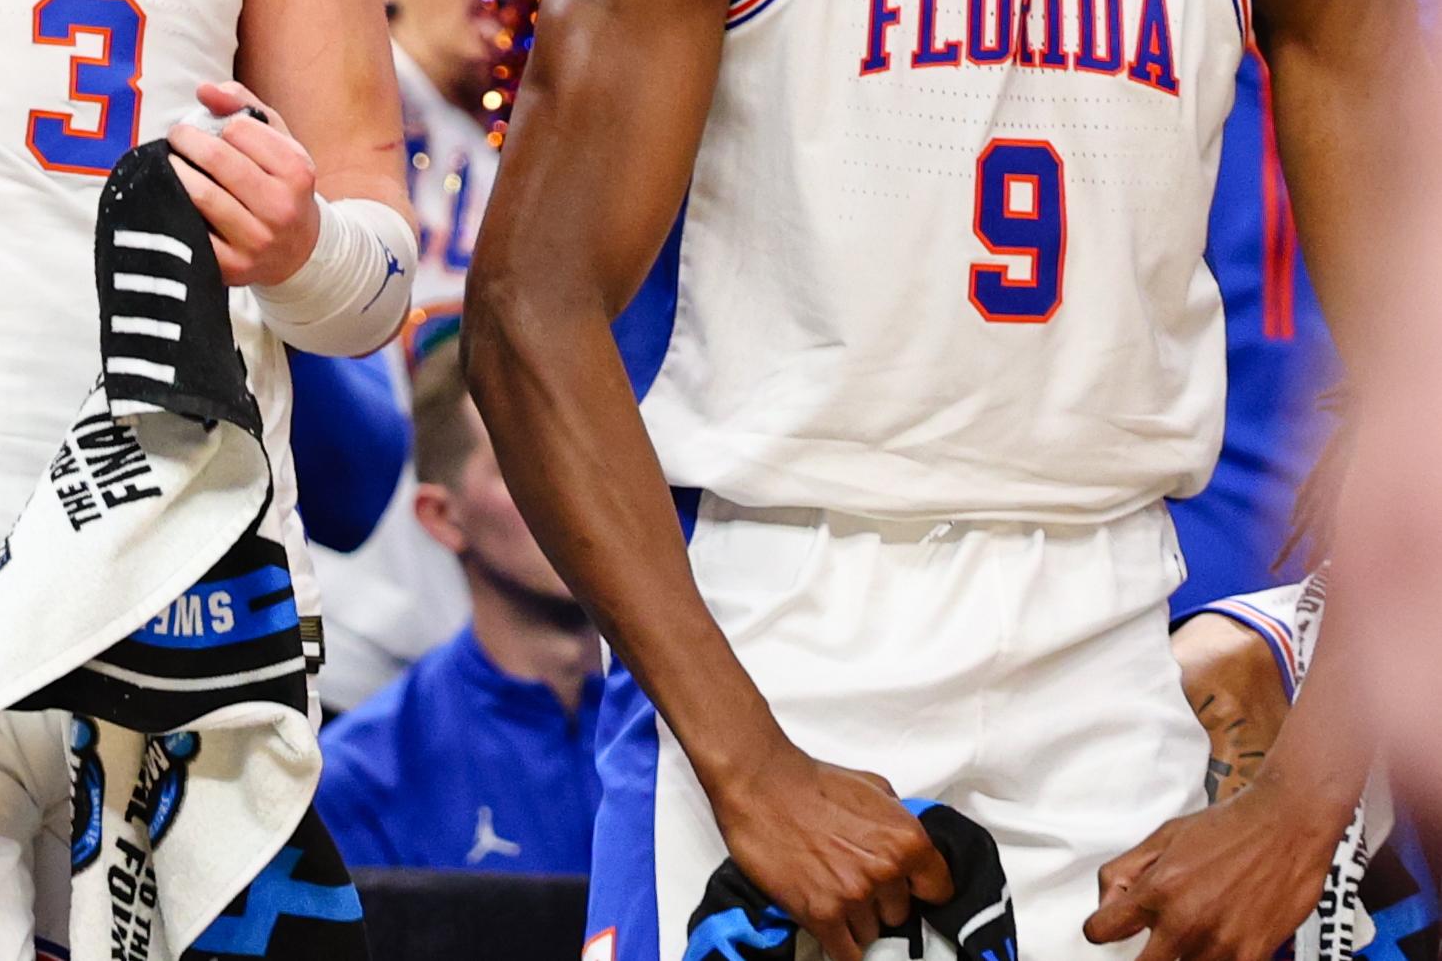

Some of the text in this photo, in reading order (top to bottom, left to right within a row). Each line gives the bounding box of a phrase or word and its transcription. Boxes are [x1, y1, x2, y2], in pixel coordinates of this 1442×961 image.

[968, 138, 1067, 323] 9
[56, 480, 103, 532] THE
[142, 590, 235, 637] SWE
